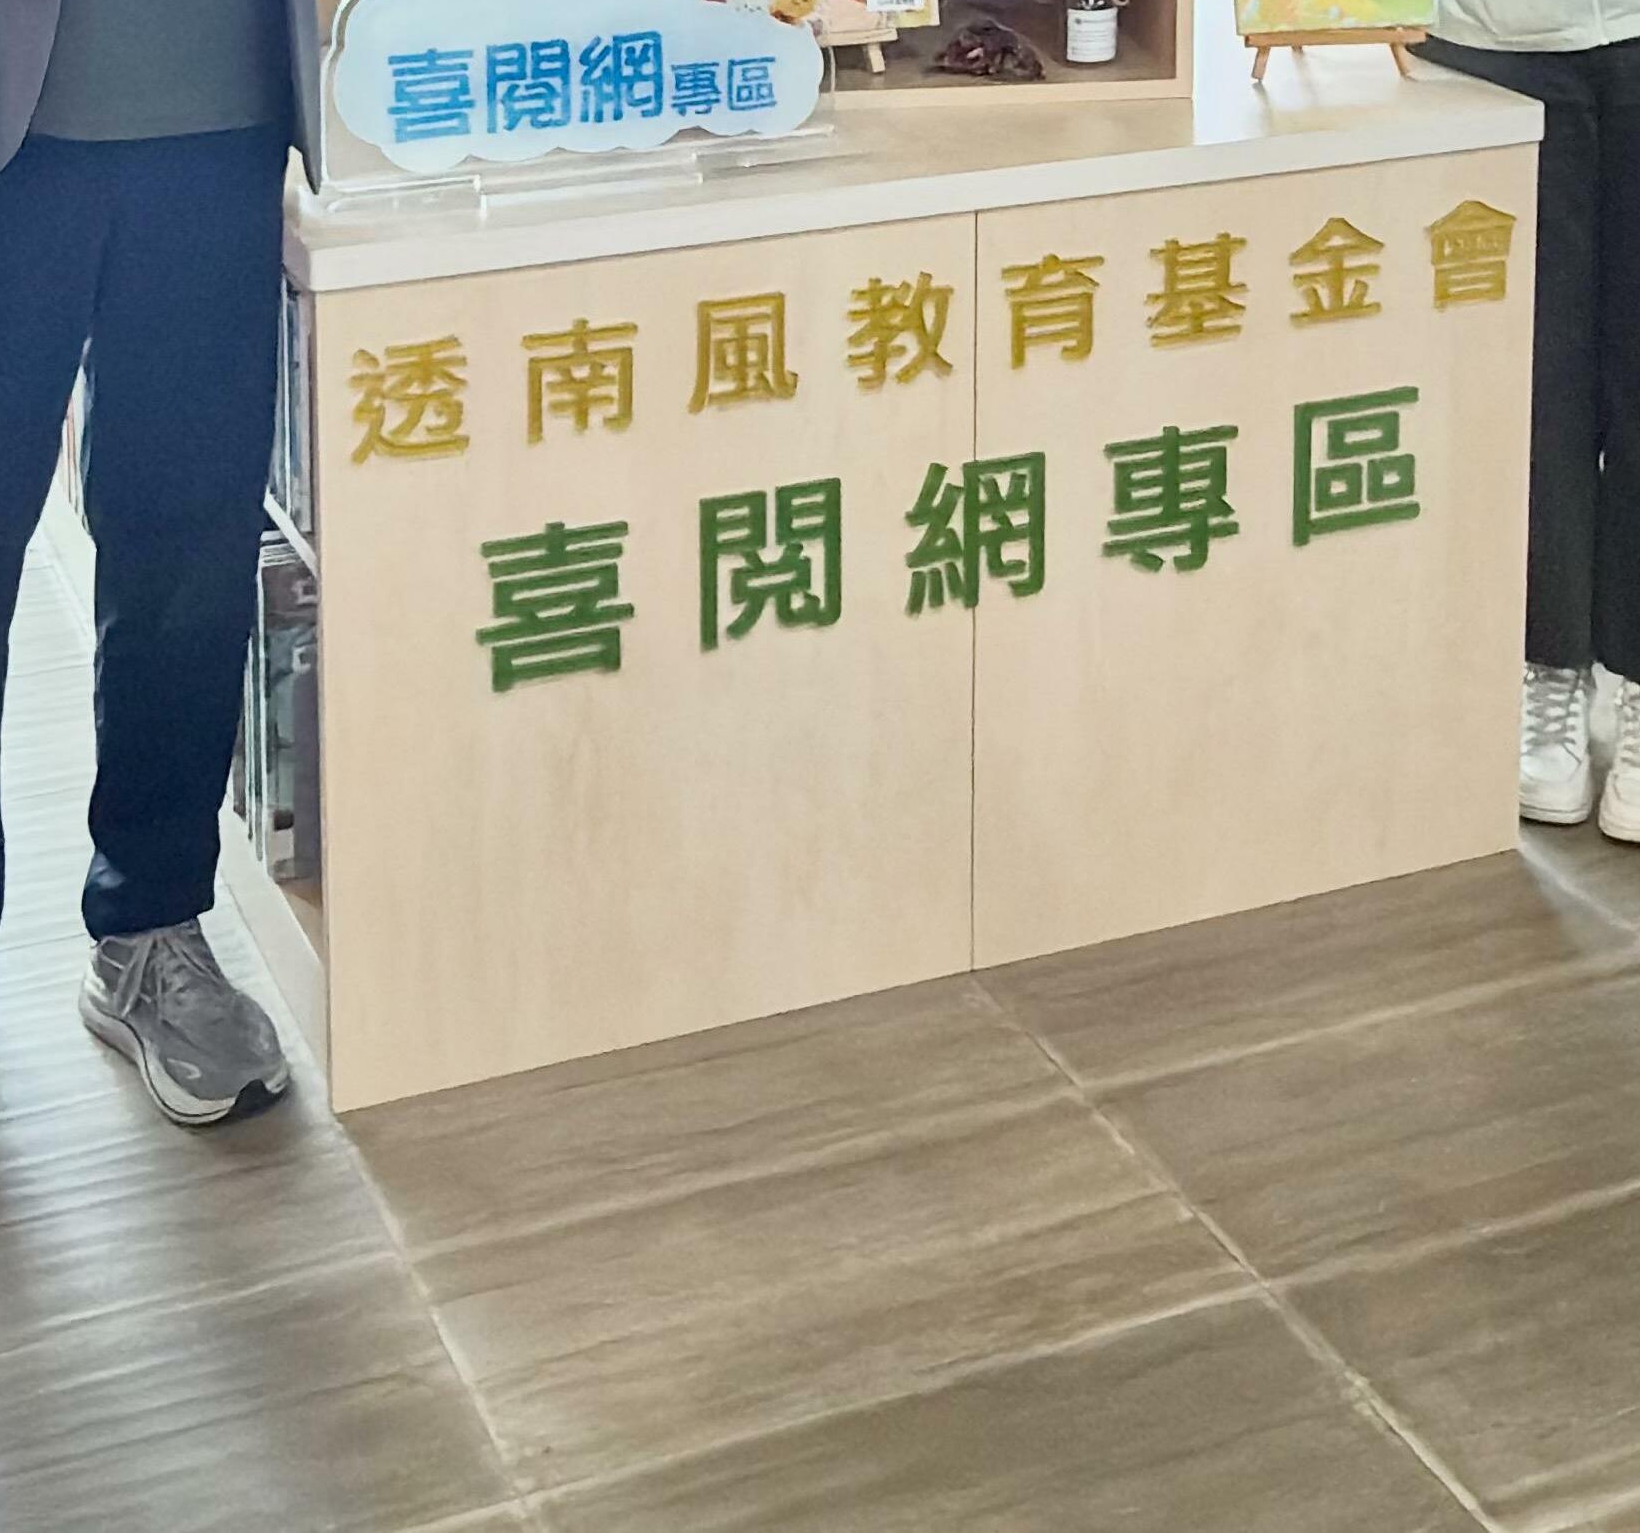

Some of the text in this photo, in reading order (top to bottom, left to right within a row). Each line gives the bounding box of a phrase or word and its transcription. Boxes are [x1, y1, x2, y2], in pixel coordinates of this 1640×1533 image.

[386, 30, 778, 144] 喜閱網專區
[347, 198, 1519, 466] 透南風教育基金會
[475, 385, 1423, 695] 喜閱網專區
